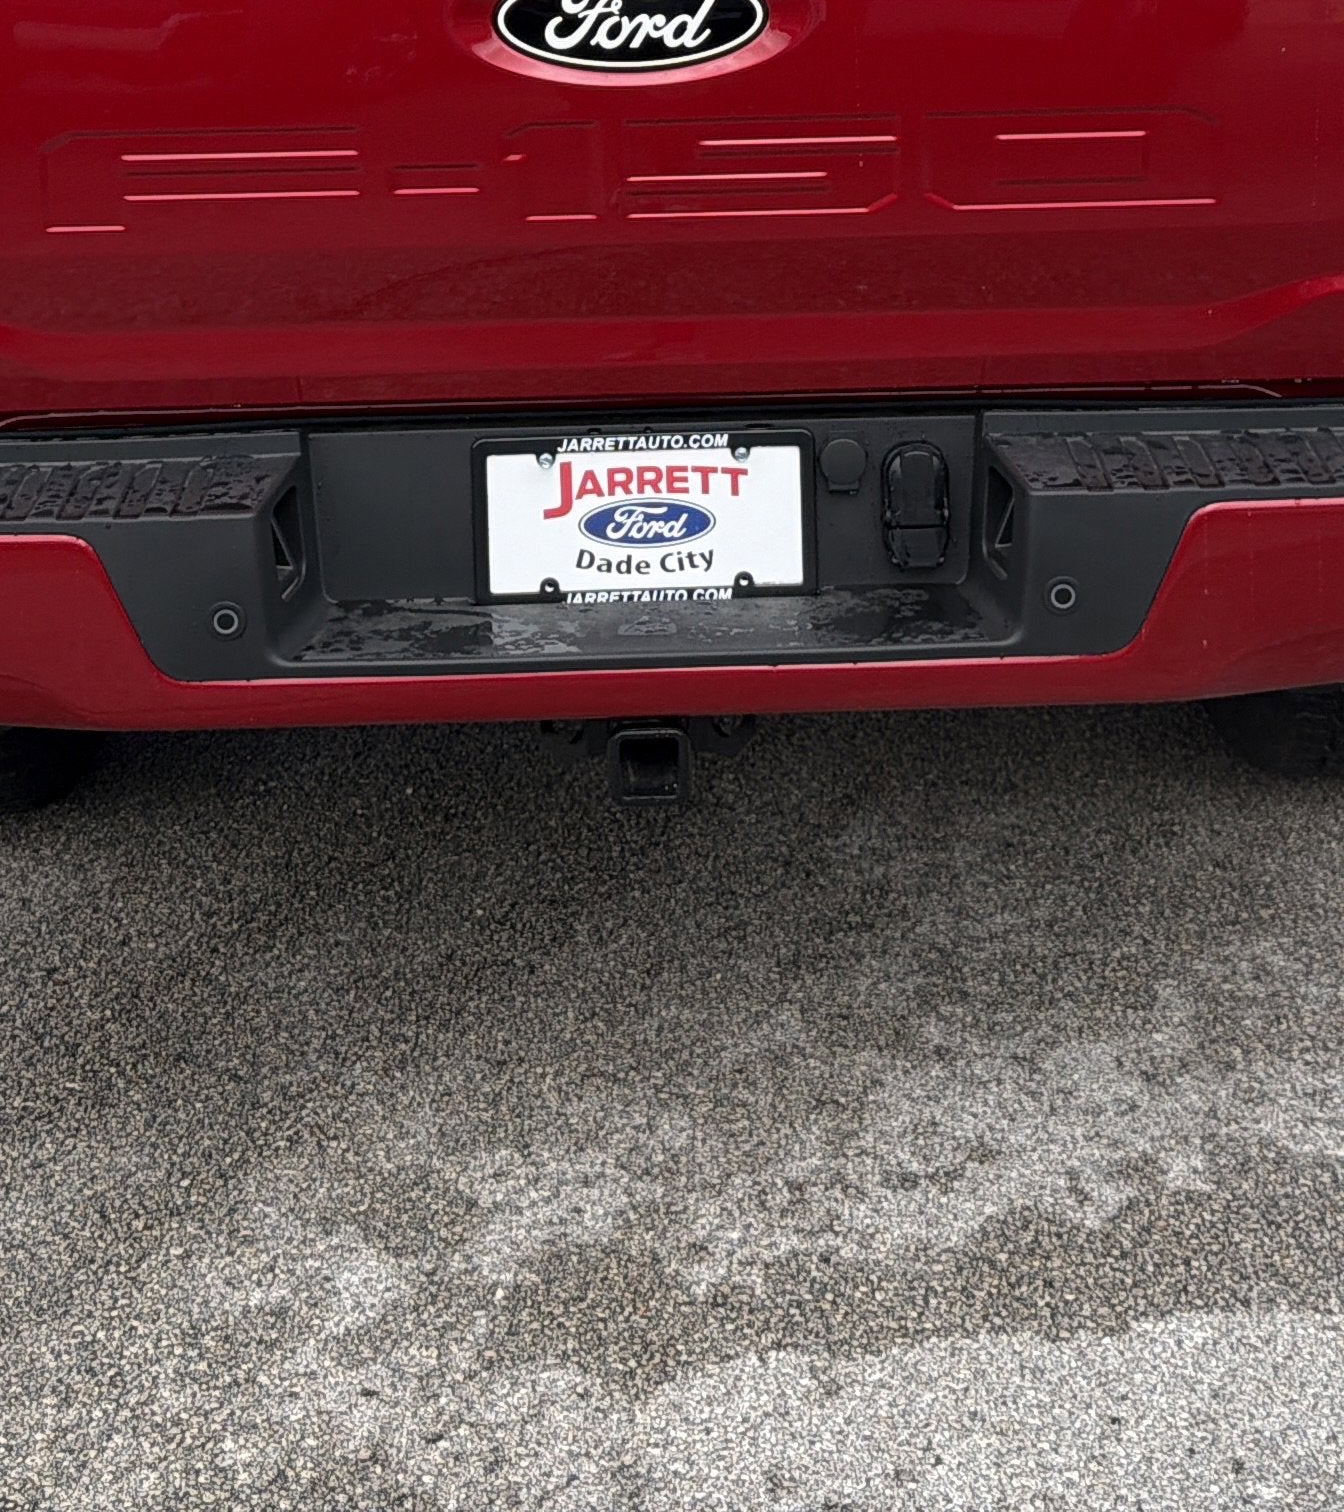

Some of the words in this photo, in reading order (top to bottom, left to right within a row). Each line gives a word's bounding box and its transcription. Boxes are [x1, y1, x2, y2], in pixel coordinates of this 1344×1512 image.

[557, 434, 728, 453] JARRETTAUTO.COM
[543, 461, 748, 520] JARRETT
[605, 506, 688, 539] Ford
[575, 549, 651, 575] Dade
[659, 548, 715, 573] City
[567, 588, 733, 604] JARRETTAUTOCOM
